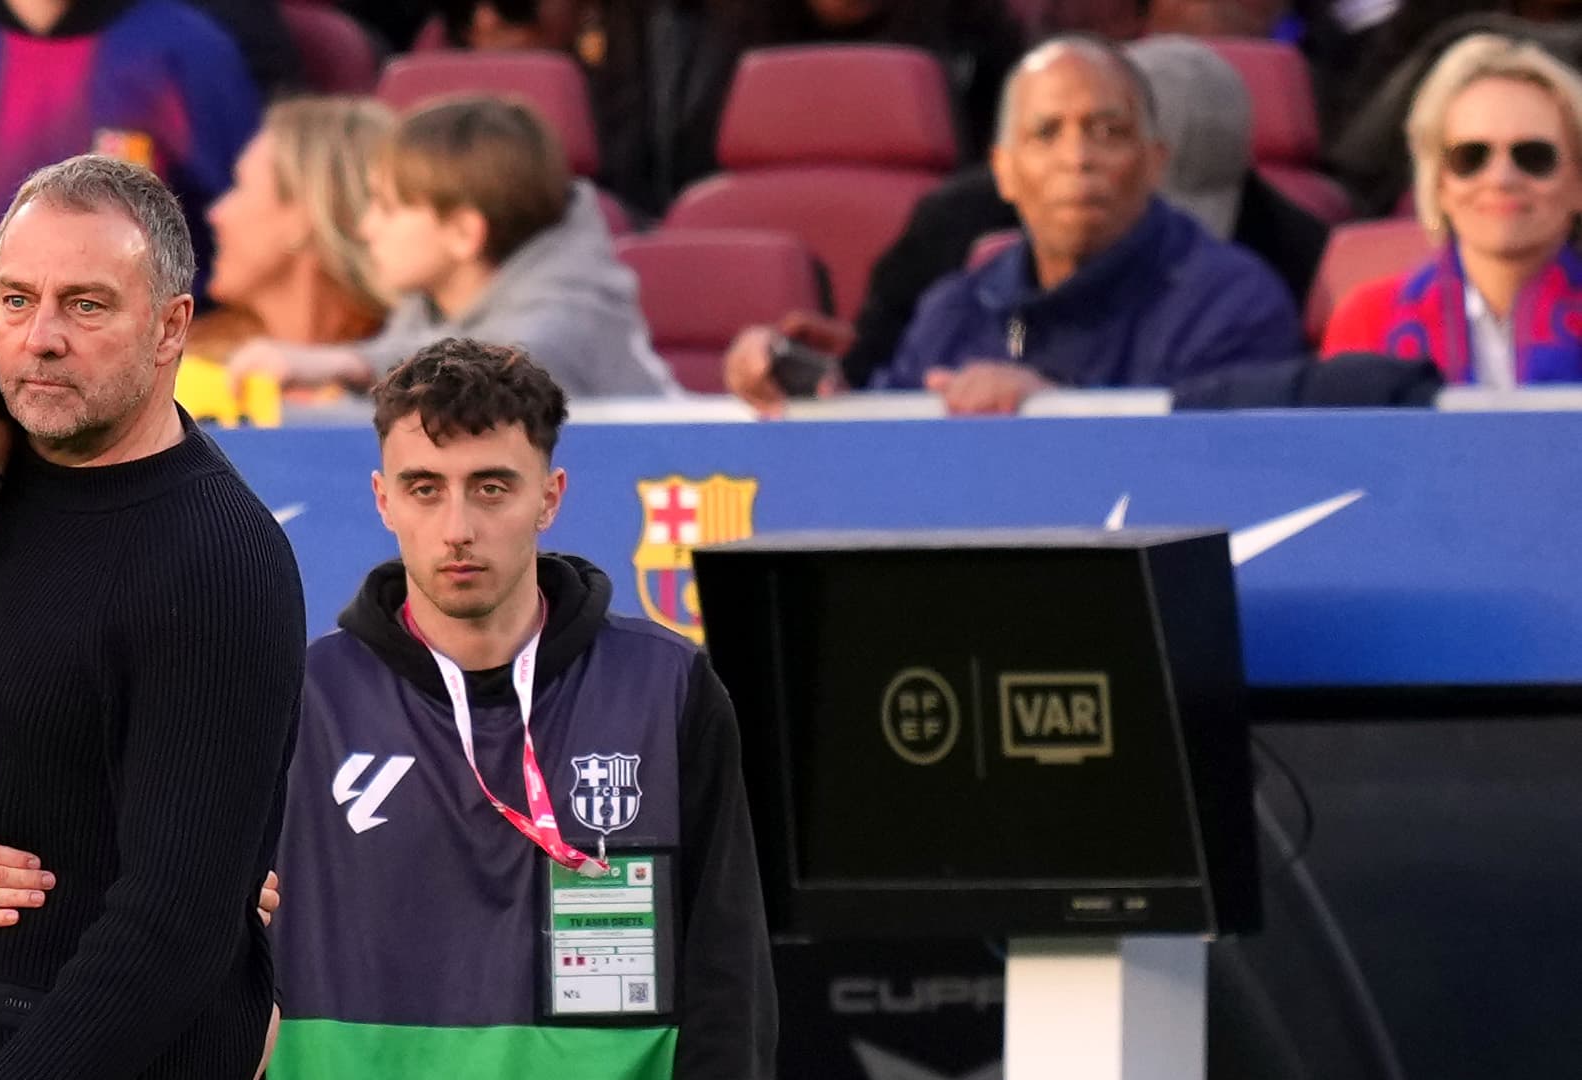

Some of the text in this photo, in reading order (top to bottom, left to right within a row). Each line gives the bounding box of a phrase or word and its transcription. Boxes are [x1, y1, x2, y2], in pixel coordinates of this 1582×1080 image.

[1014, 691, 1098, 737] VAR
[593, 786, 620, 797] FCB
[829, 976, 1006, 1013] CUP
